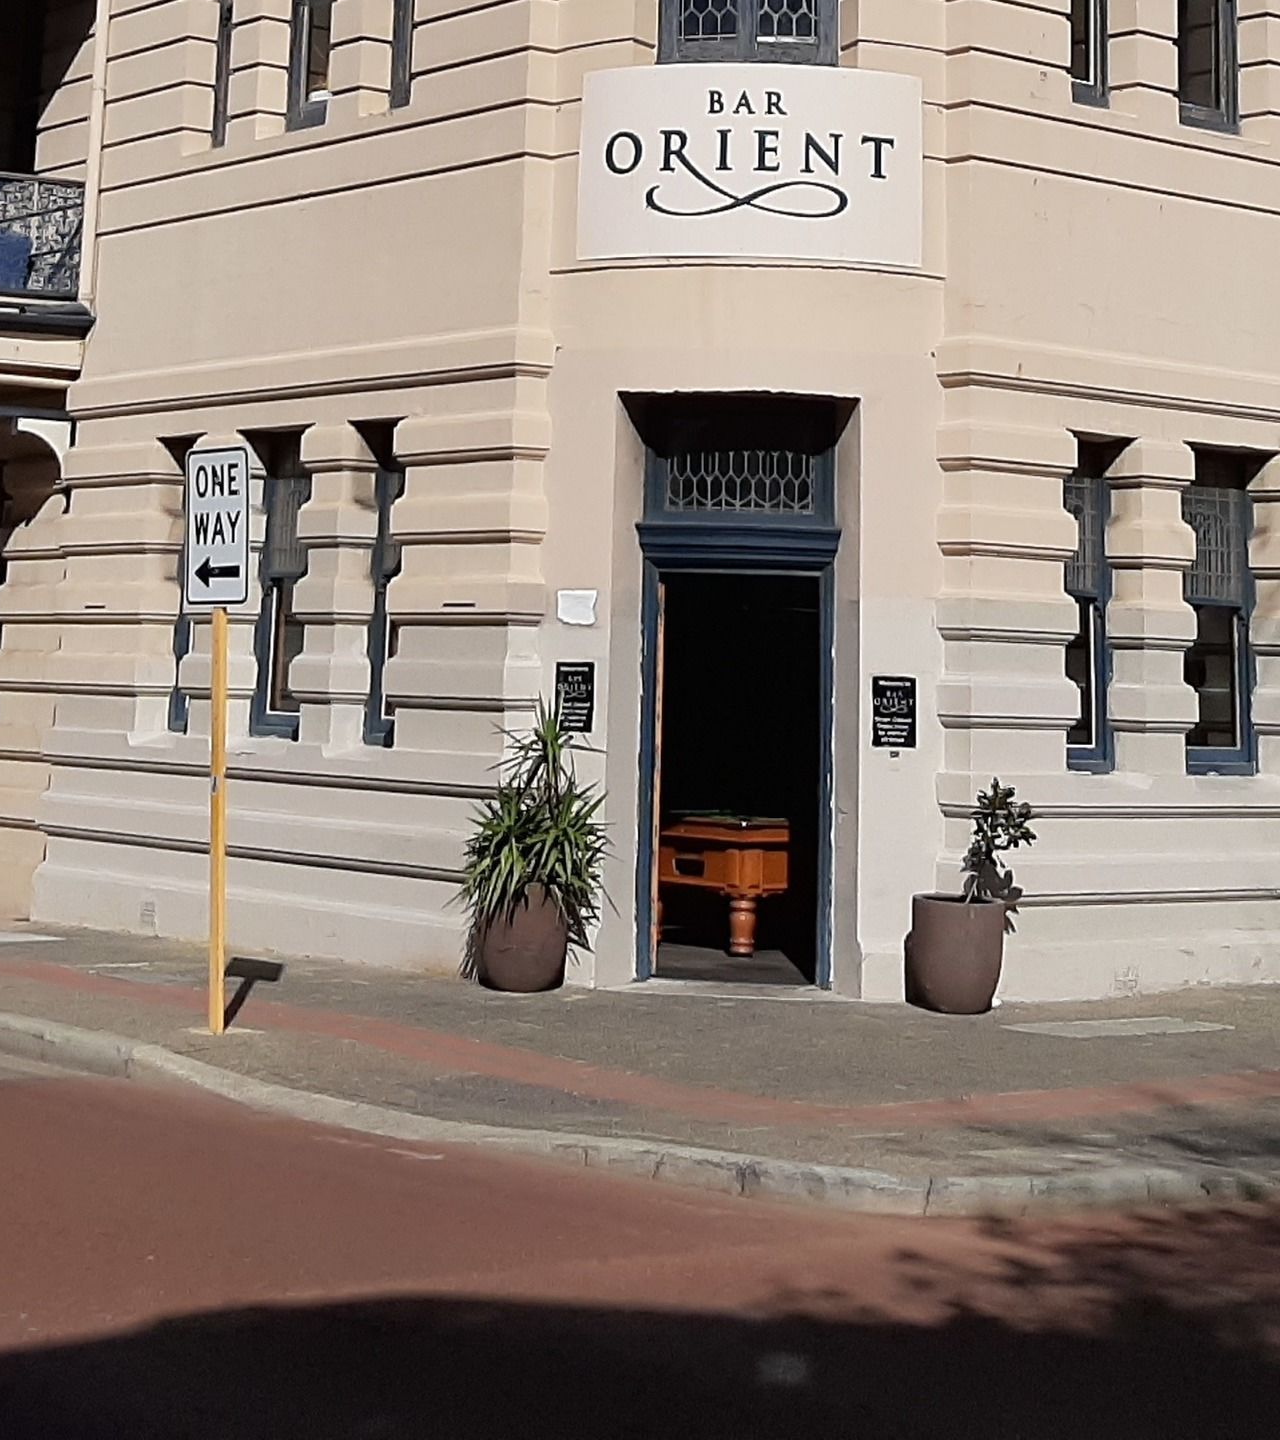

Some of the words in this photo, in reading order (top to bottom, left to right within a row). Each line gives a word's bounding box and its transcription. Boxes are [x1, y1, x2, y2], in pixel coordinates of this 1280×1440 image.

[708, 89, 788, 116] BAR
[604, 128, 895, 217] ORIENT
[195, 462, 240, 498] ONE
[193, 510, 241, 547] WAY
